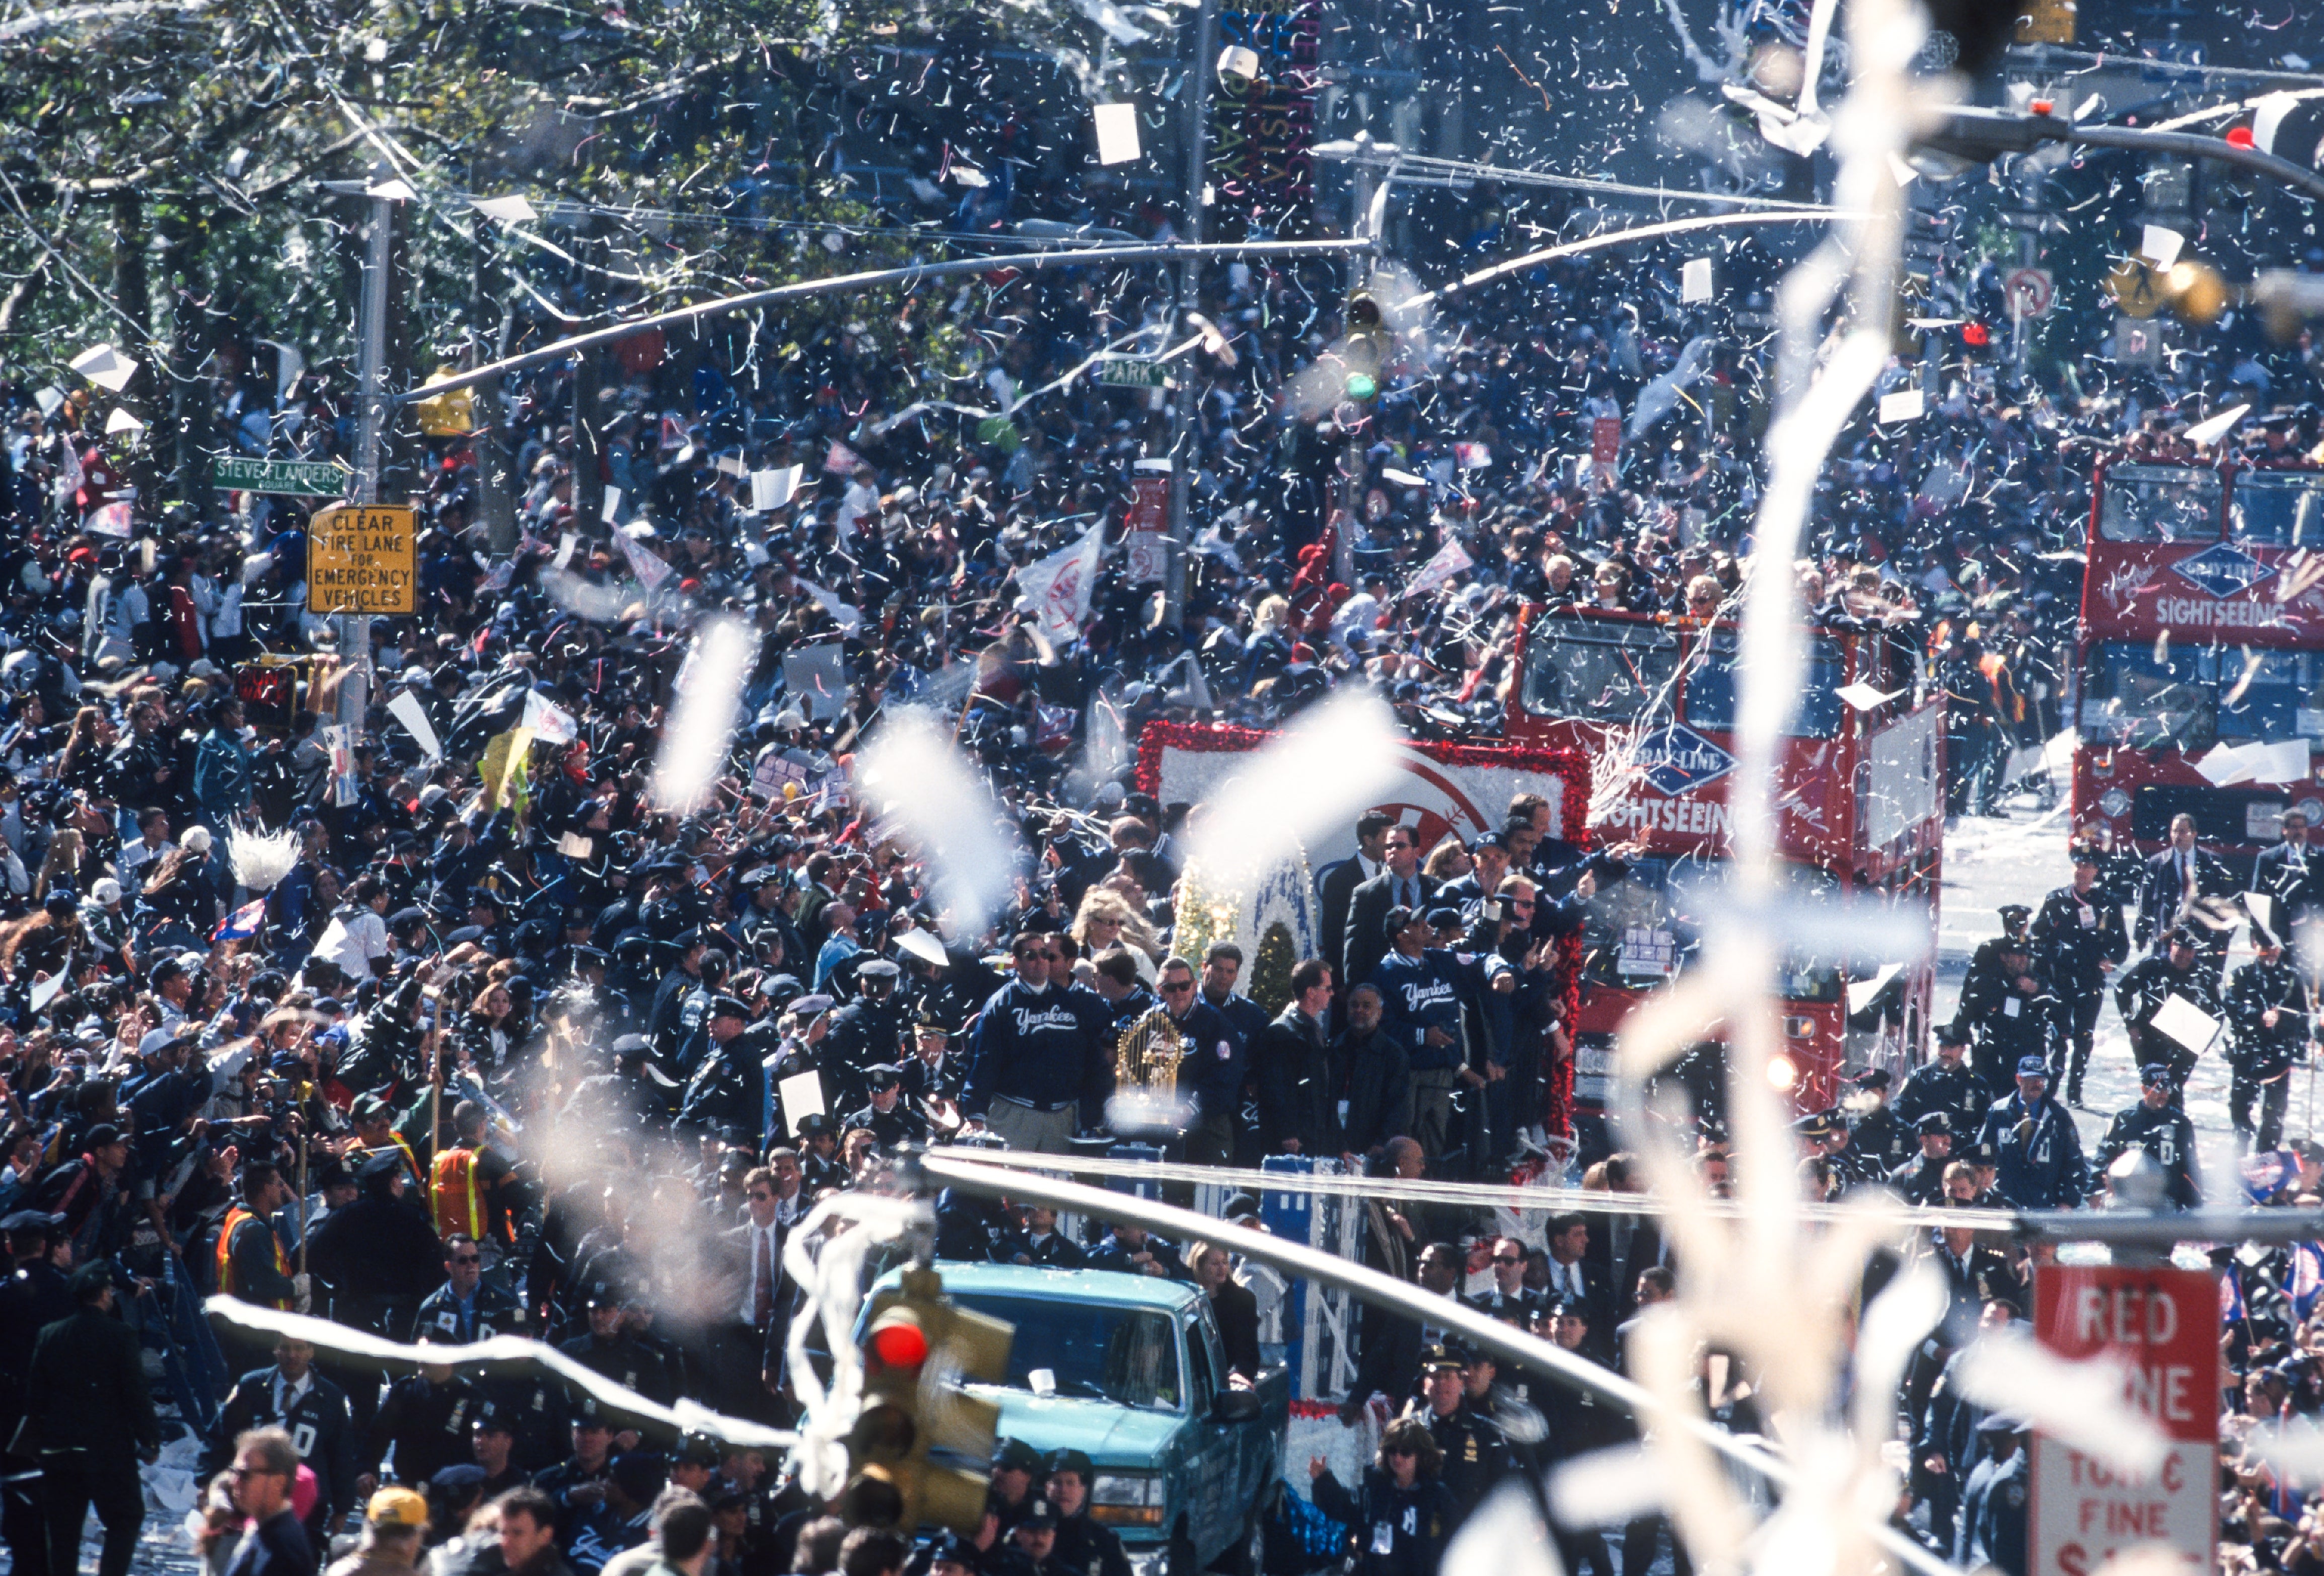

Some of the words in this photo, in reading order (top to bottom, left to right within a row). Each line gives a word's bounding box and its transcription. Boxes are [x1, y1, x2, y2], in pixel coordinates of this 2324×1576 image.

[1217, 11, 1293, 55] SEE
[1211, 72, 1250, 180] PLAY
[1103, 360, 1152, 383] PARK
[217, 459, 262, 479] STEVE
[265, 463, 340, 483] FLANDERS
[332, 515, 393, 531] CLEAR
[321, 534, 355, 551] FIRE
[364, 535, 403, 553] LANE
[351, 554, 374, 566] FOR
[315, 568, 410, 586] EMERGENCY
[323, 589, 401, 606] VEHICLES
[2156, 596, 2286, 627] SIGHTSEEING
[1679, 750, 1722, 770] LINE
[1593, 796, 1737, 835] IGHTSEEIN
[2075, 1285, 2178, 1344] RED
[2078, 1497, 2169, 1537] FINE
